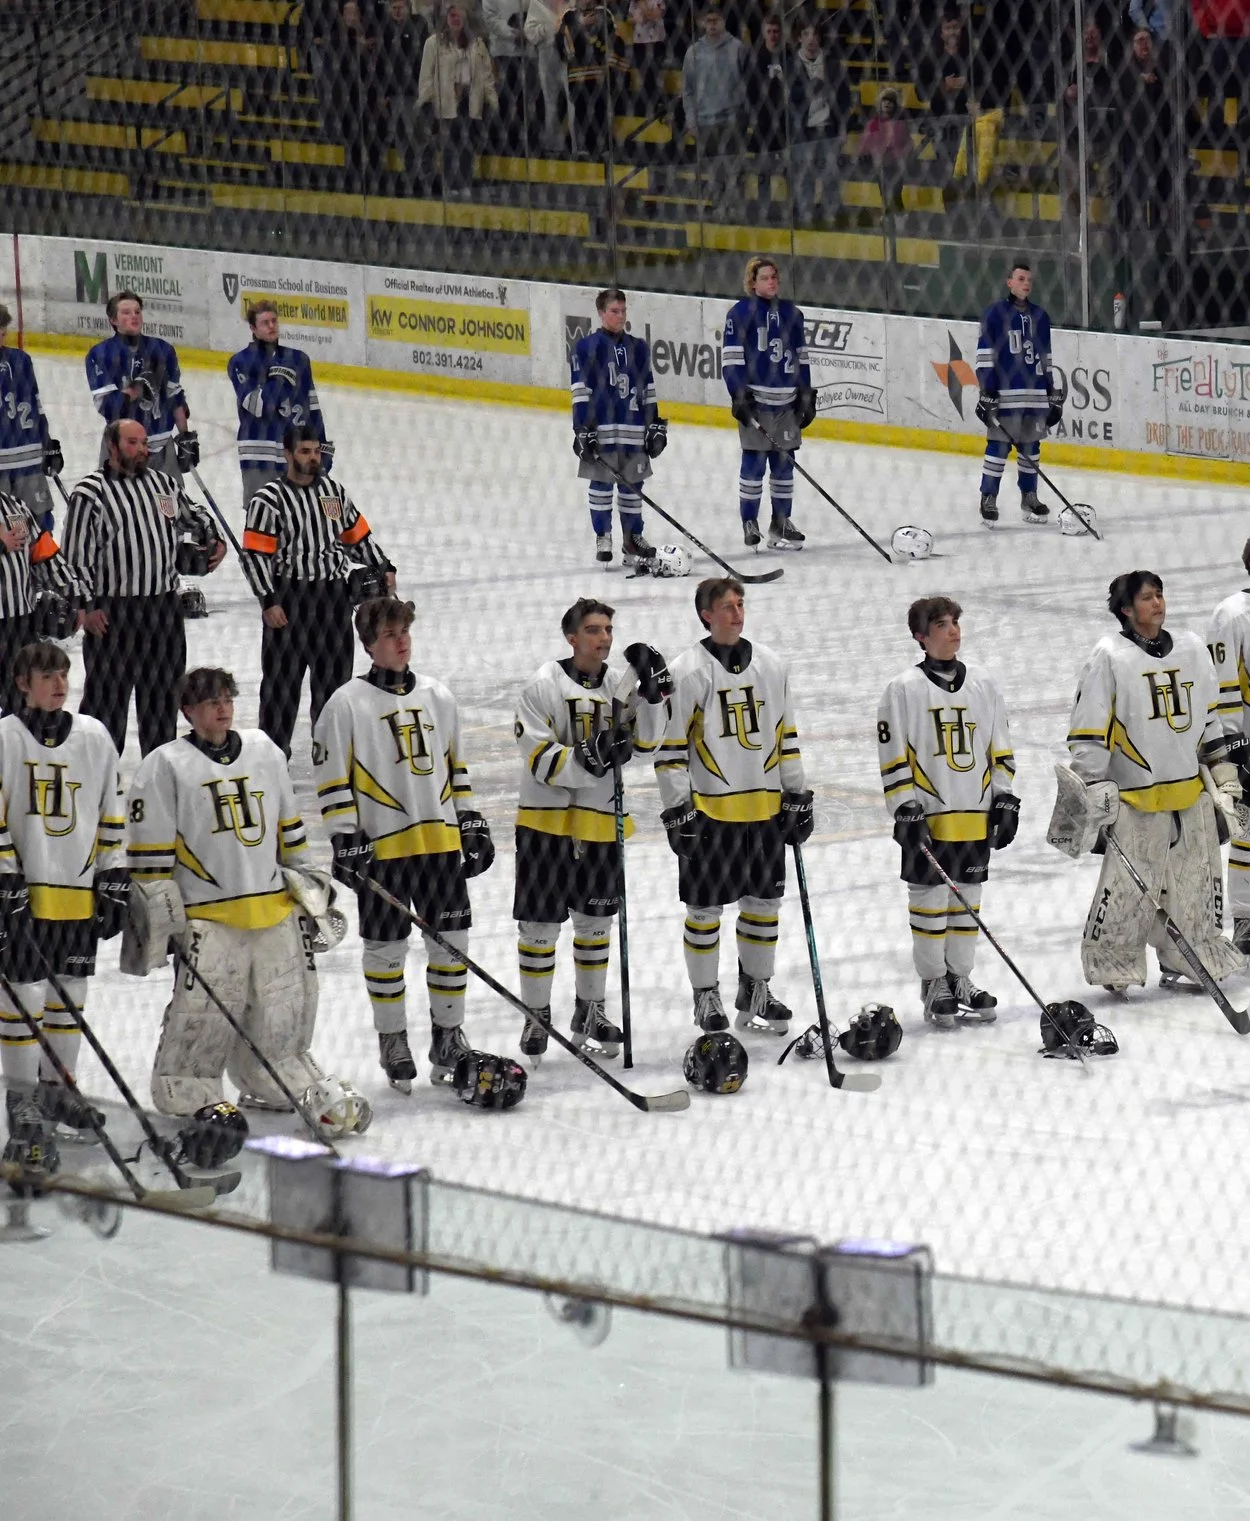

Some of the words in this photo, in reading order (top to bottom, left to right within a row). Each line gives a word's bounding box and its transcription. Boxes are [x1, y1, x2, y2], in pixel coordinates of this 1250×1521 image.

[114, 253, 164, 274] VERMONT
[115, 275, 182, 296] MECHANICAL
[240, 275, 276, 289] Grossman
[278, 279, 303, 292] School
[304, 280, 313, 292] of
[314, 280, 348, 296] Business
[384, 278, 408, 292] Official
[410, 280, 434, 294] Realtor
[436, 282, 443, 294] of
[444, 284, 462, 296] UVM
[463, 286, 494, 299] Athletics
[301, 303, 326, 321] World
[328, 306, 347, 322] MBA
[159, 325, 184, 338] COUNTS
[398, 312, 455, 335] CONNOR
[459, 316, 525, 342] JOHNSON
[413, 350, 483, 370] 802.391.4224
[844, 388, 875, 403] Owned
[1178, 402, 1192, 413] ALL
[1194, 404, 1210, 415] DAY
[1212, 404, 1244, 418] BRUNCH
[1146, 420, 1170, 448] DROP
[1176, 424, 1193, 449] THE
[878, 720, 891, 744] 8
[1213, 876, 1223, 930] CCM
[1092, 887, 1111, 942] CCM
